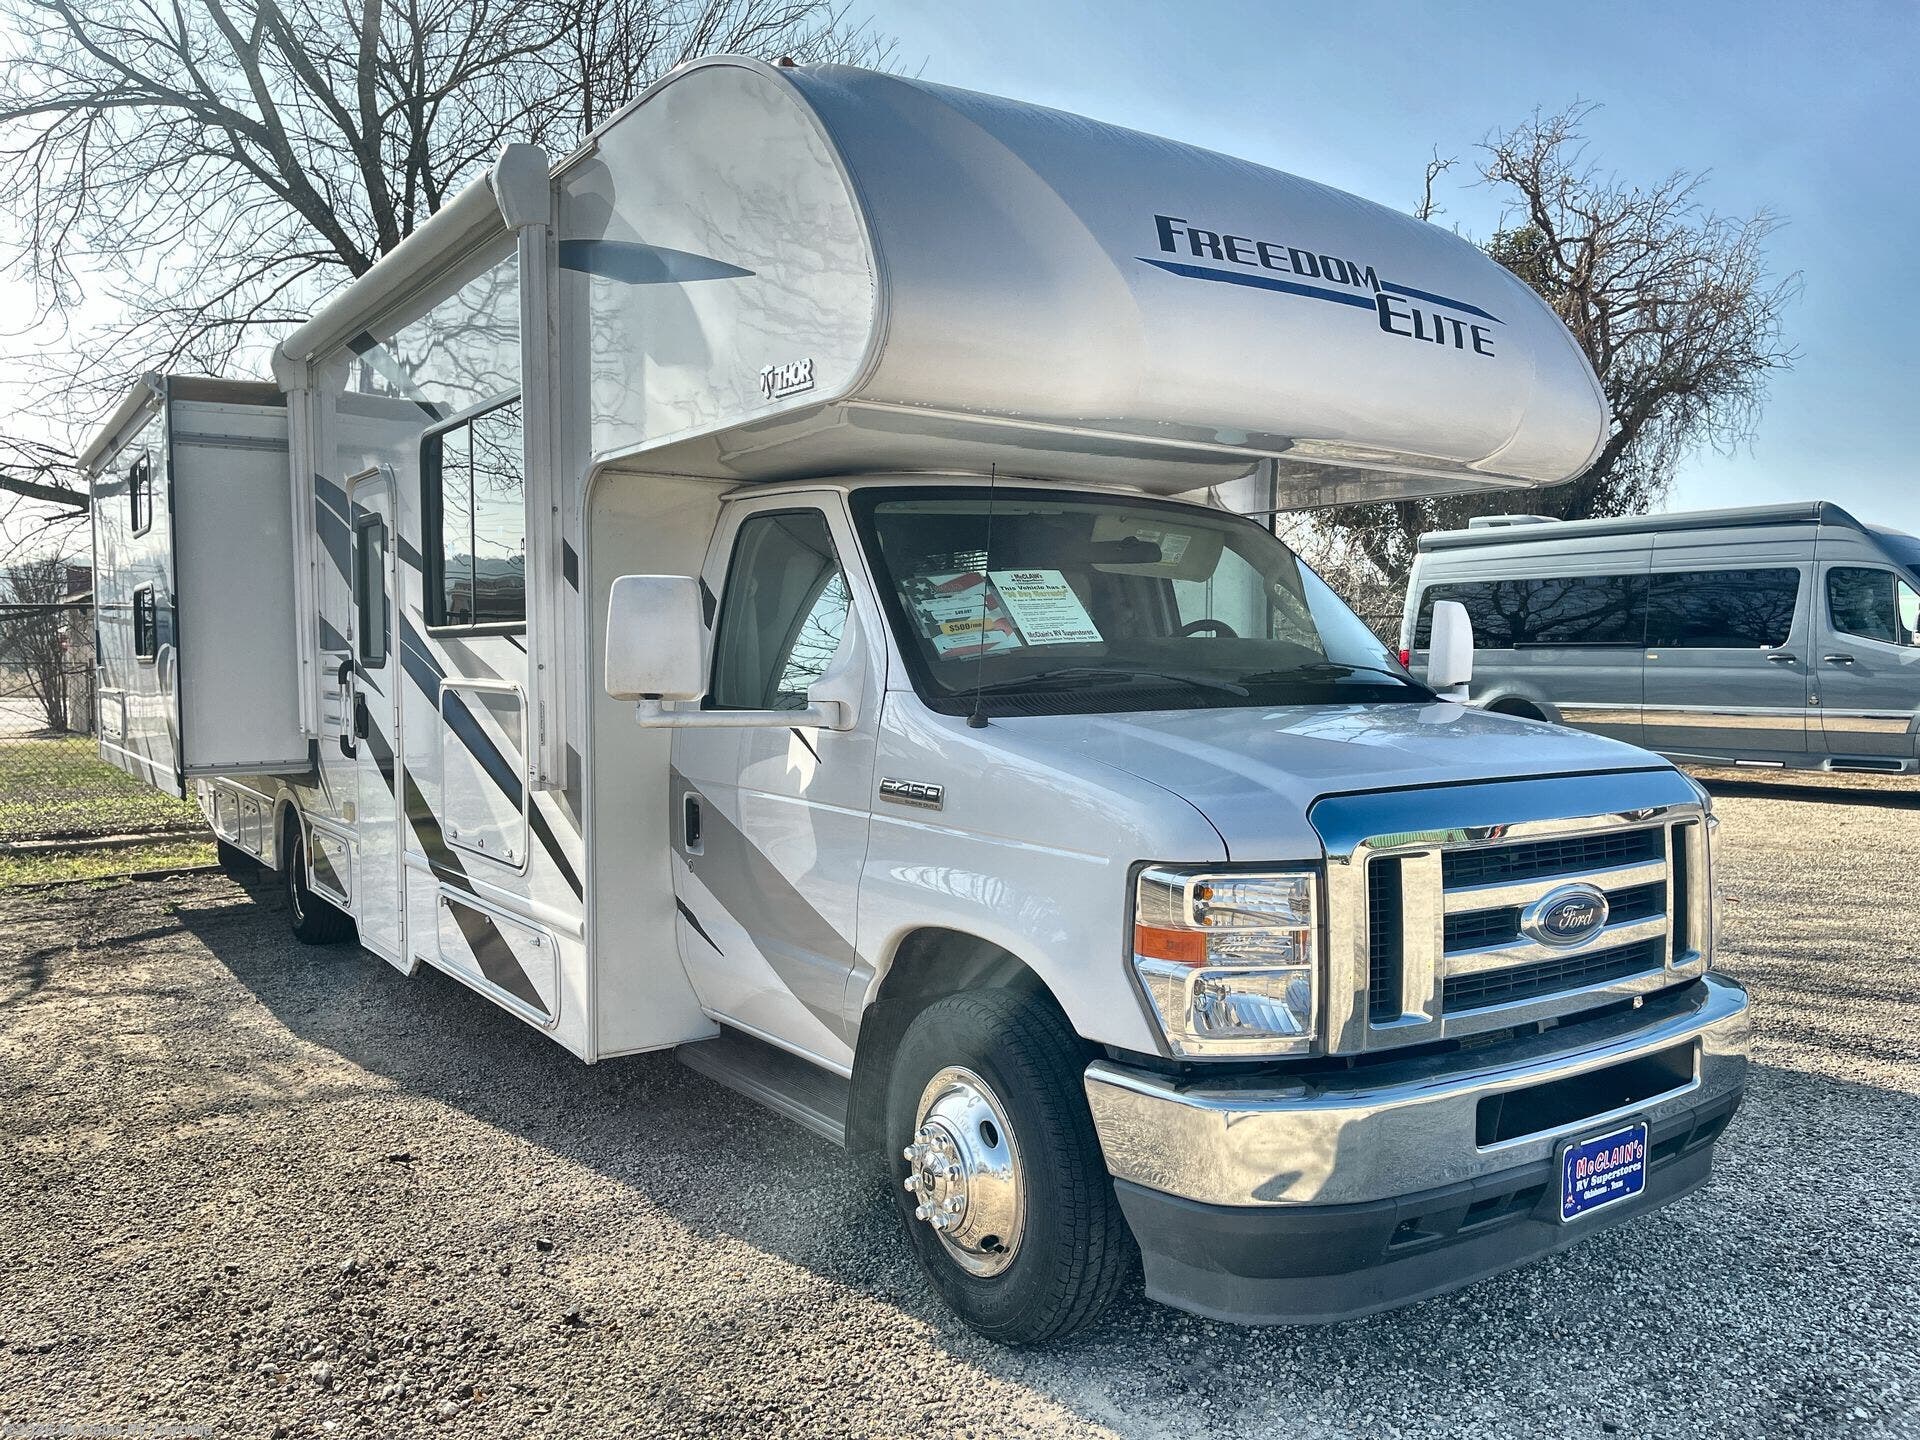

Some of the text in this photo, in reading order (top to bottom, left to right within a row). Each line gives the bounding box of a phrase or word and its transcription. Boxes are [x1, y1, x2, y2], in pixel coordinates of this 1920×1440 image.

[1154, 213, 1381, 293] FREEDOM
[1376, 293, 1495, 357] ELITE
[774, 358, 814, 391] THOR
[1559, 904, 1594, 930] Ford
[1576, 1161, 1642, 1192] RV Superstores
